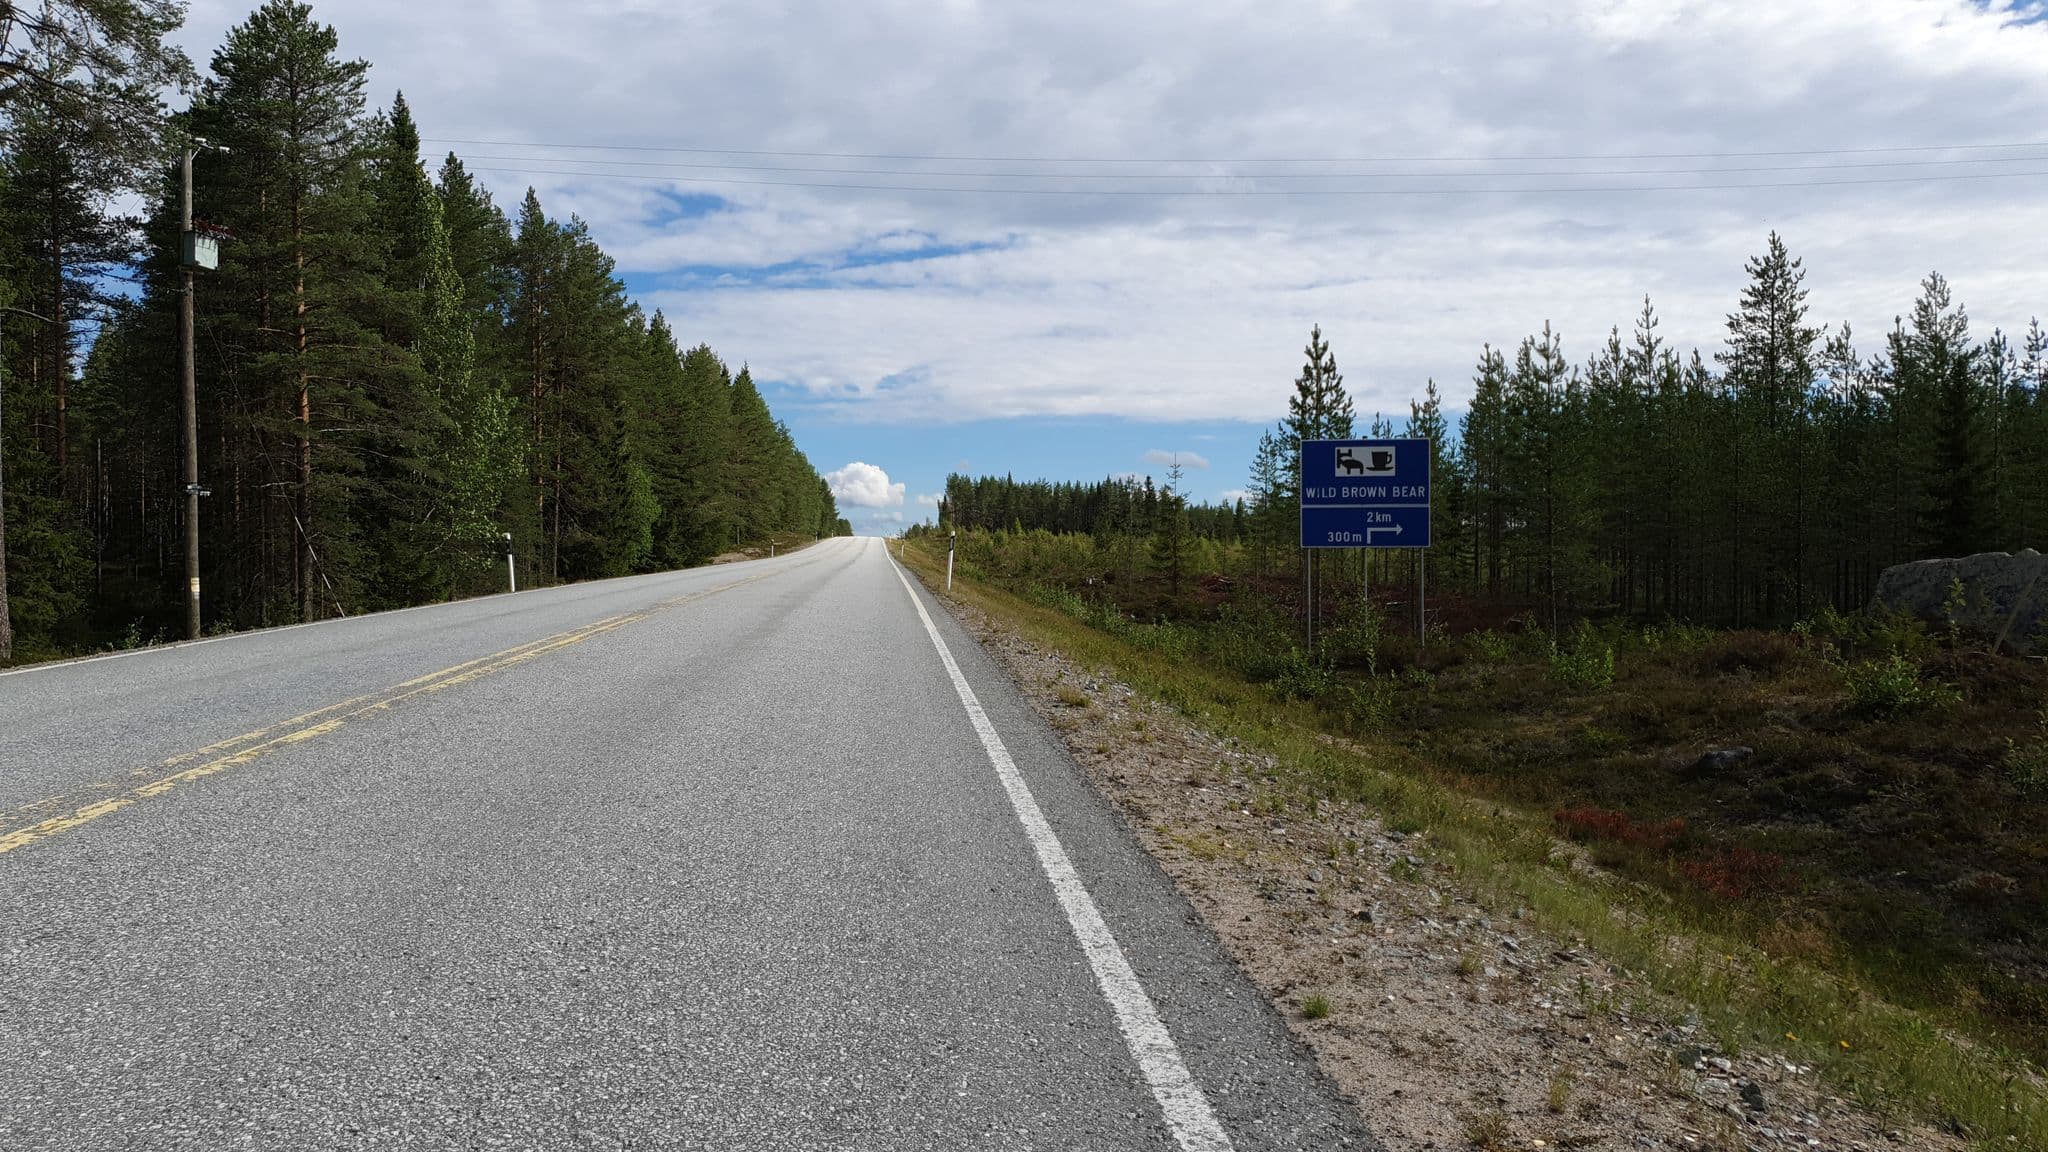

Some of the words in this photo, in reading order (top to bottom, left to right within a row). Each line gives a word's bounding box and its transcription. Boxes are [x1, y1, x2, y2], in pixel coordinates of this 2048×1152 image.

[1306, 487, 1336, 498] WILD
[1342, 486, 1386, 498] BROWN
[1392, 486, 1425, 498] BEAR
